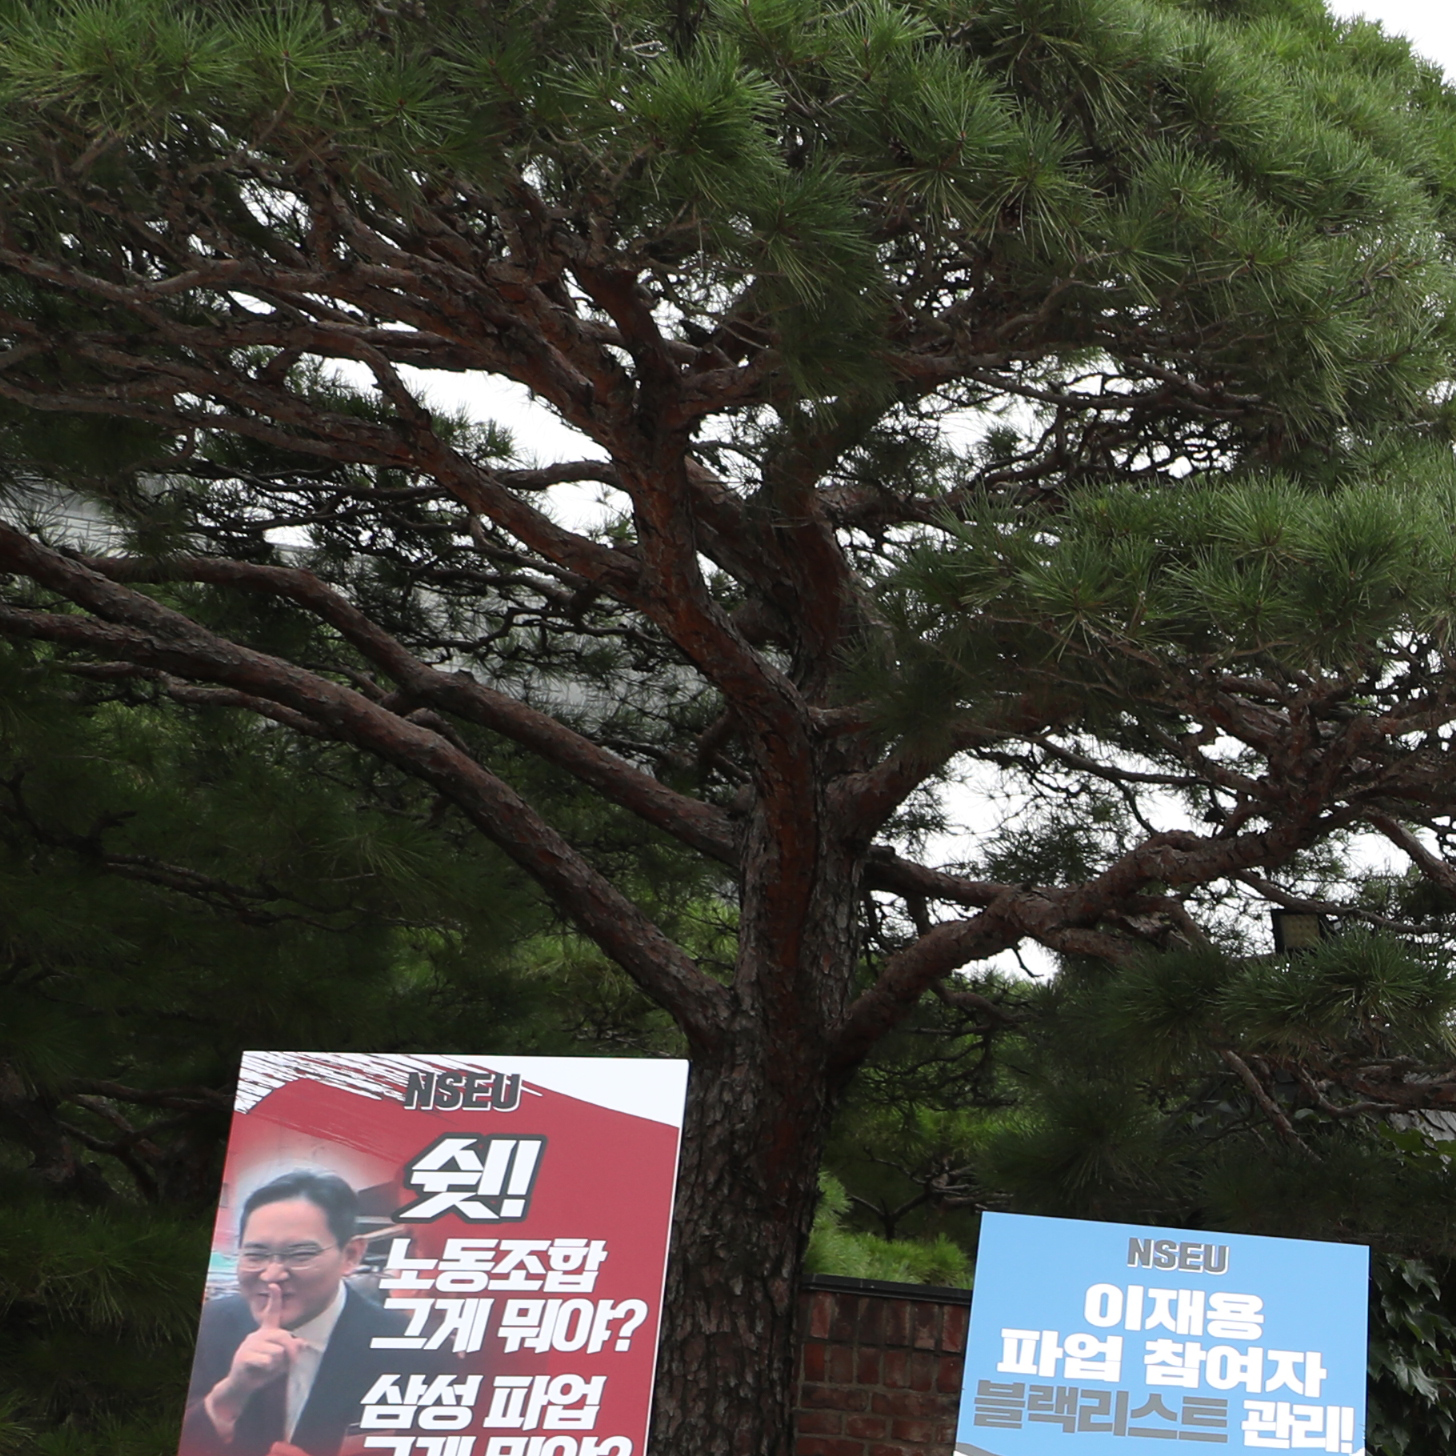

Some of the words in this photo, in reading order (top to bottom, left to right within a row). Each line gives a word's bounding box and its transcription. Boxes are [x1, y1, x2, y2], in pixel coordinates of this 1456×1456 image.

[404, 1072, 521, 1111] NSEU
[397, 1136, 544, 1220] 쉿!
[379, 1238, 607, 1293] 노동조합
[1127, 1237, 1230, 1275] NSEU
[370, 1298, 494, 1353] 그게
[499, 1298, 648, 1353] 뭐야?
[1084, 1283, 1265, 1340] 이재용
[996, 1327, 1123, 1382] 파업
[1144, 1337, 1327, 1398] 참여자
[360, 1374, 482, 1430] 삼성
[483, 1374, 606, 1430] 파업
[973, 1379, 1228, 1443] 블랙리스트
[1240, 1400, 1354, 1454] 관리!
